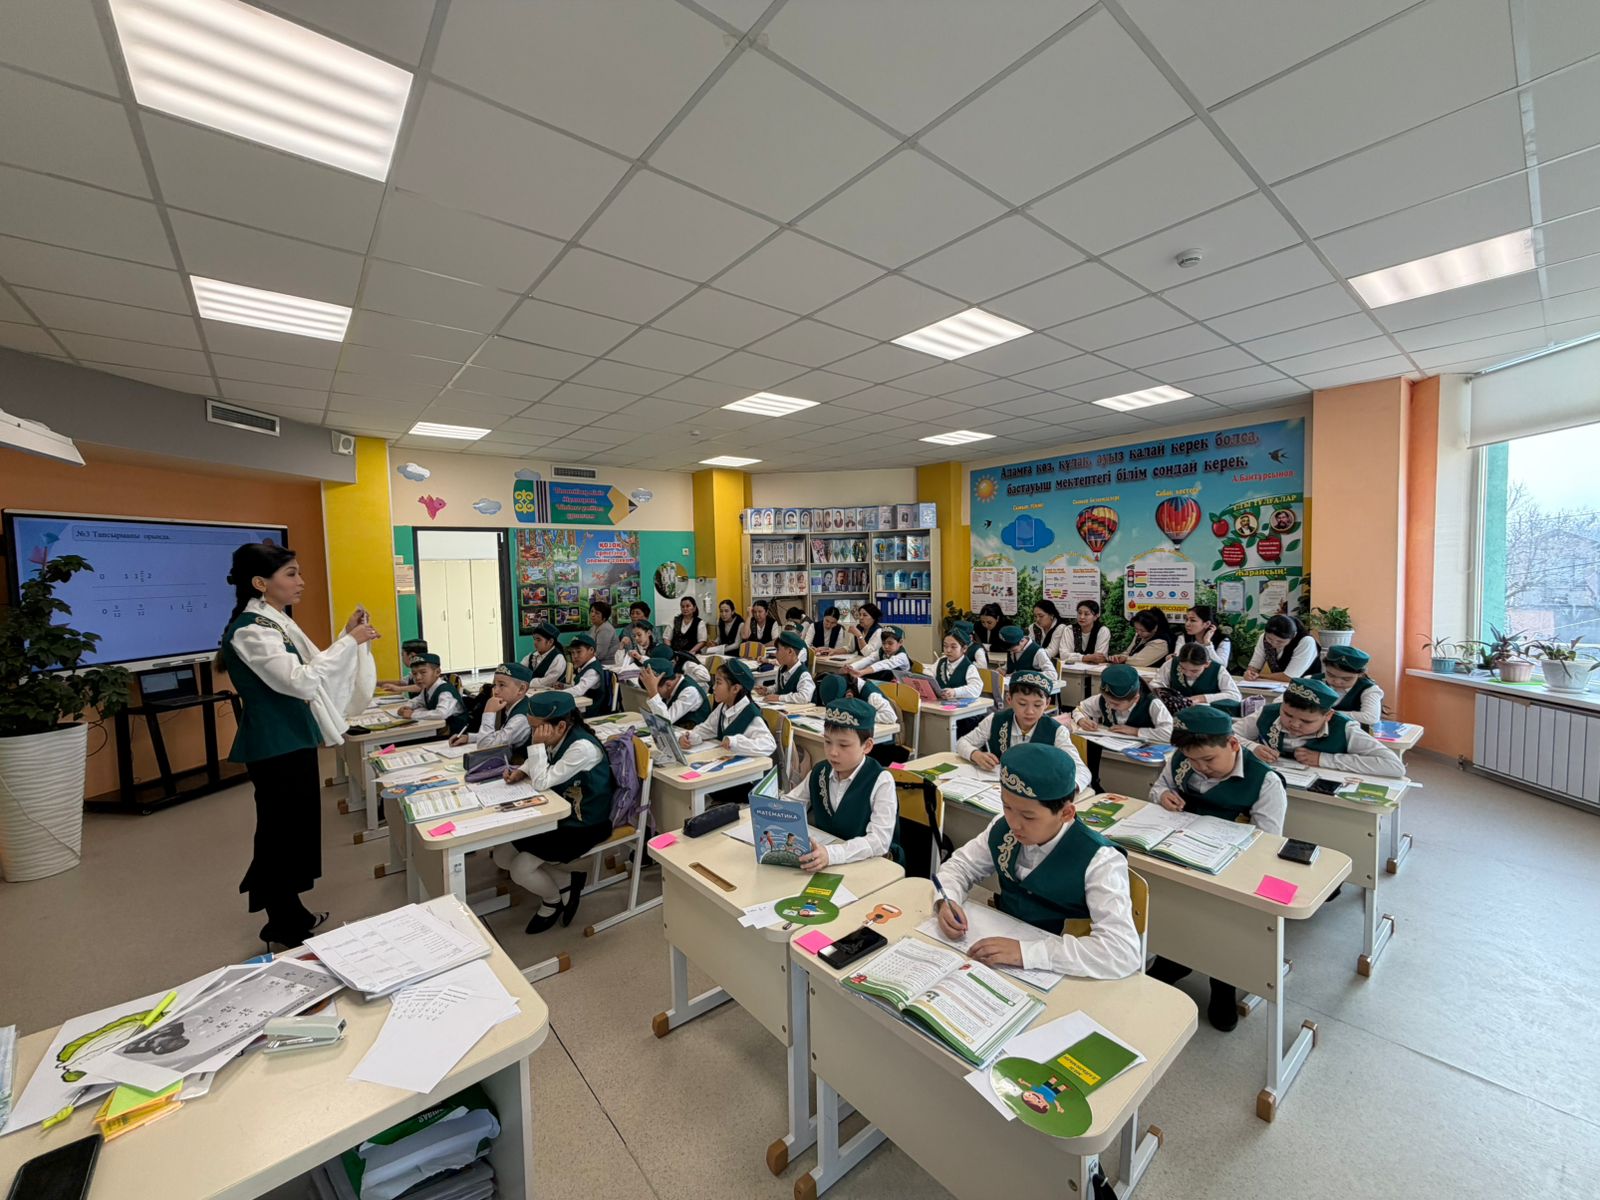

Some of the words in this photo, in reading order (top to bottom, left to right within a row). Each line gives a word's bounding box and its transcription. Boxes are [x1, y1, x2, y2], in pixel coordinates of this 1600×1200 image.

[1171, 438, 1209, 457] керек
[1007, 480, 1052, 497] бастауыш
[1056, 470, 1111, 489] мектептегі
[1116, 467, 1147, 482] білім
[1153, 458, 1198, 478] сондай
[1204, 455, 1249, 474] керек.
[756, 809, 798, 820] МАТЕМАТИКА
